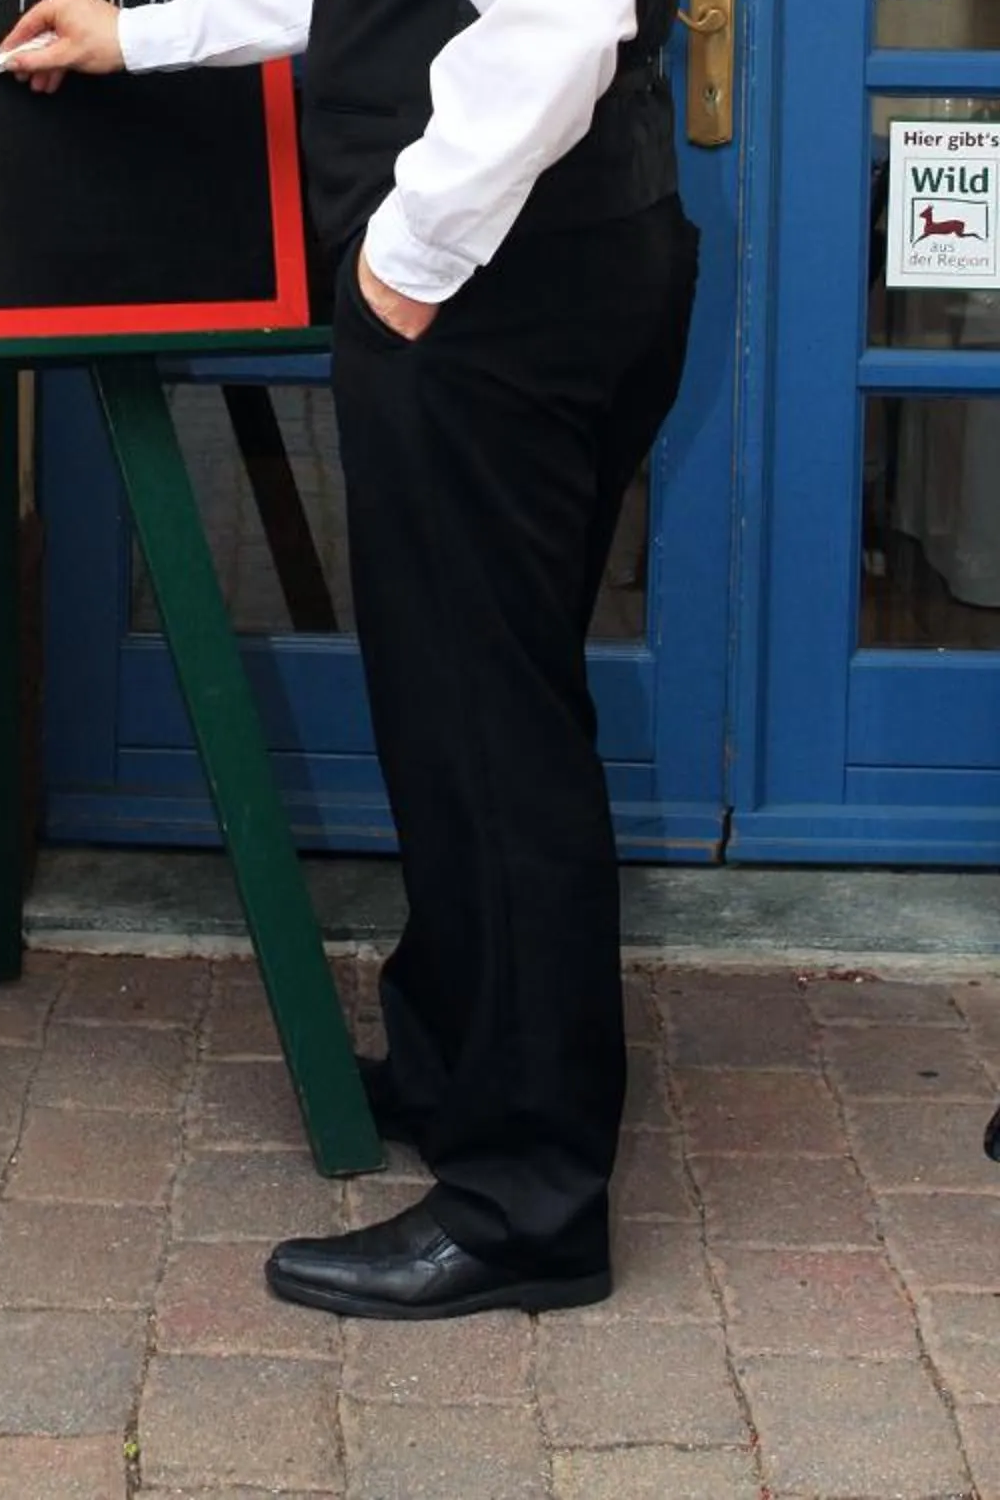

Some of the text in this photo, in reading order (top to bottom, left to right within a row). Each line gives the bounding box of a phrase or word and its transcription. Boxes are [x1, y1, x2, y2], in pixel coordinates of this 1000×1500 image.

[904, 131, 942, 146] Hier
[911, 166, 989, 193] Wild
[930, 243, 955, 252] aus
[909, 253, 989, 268] der Region
